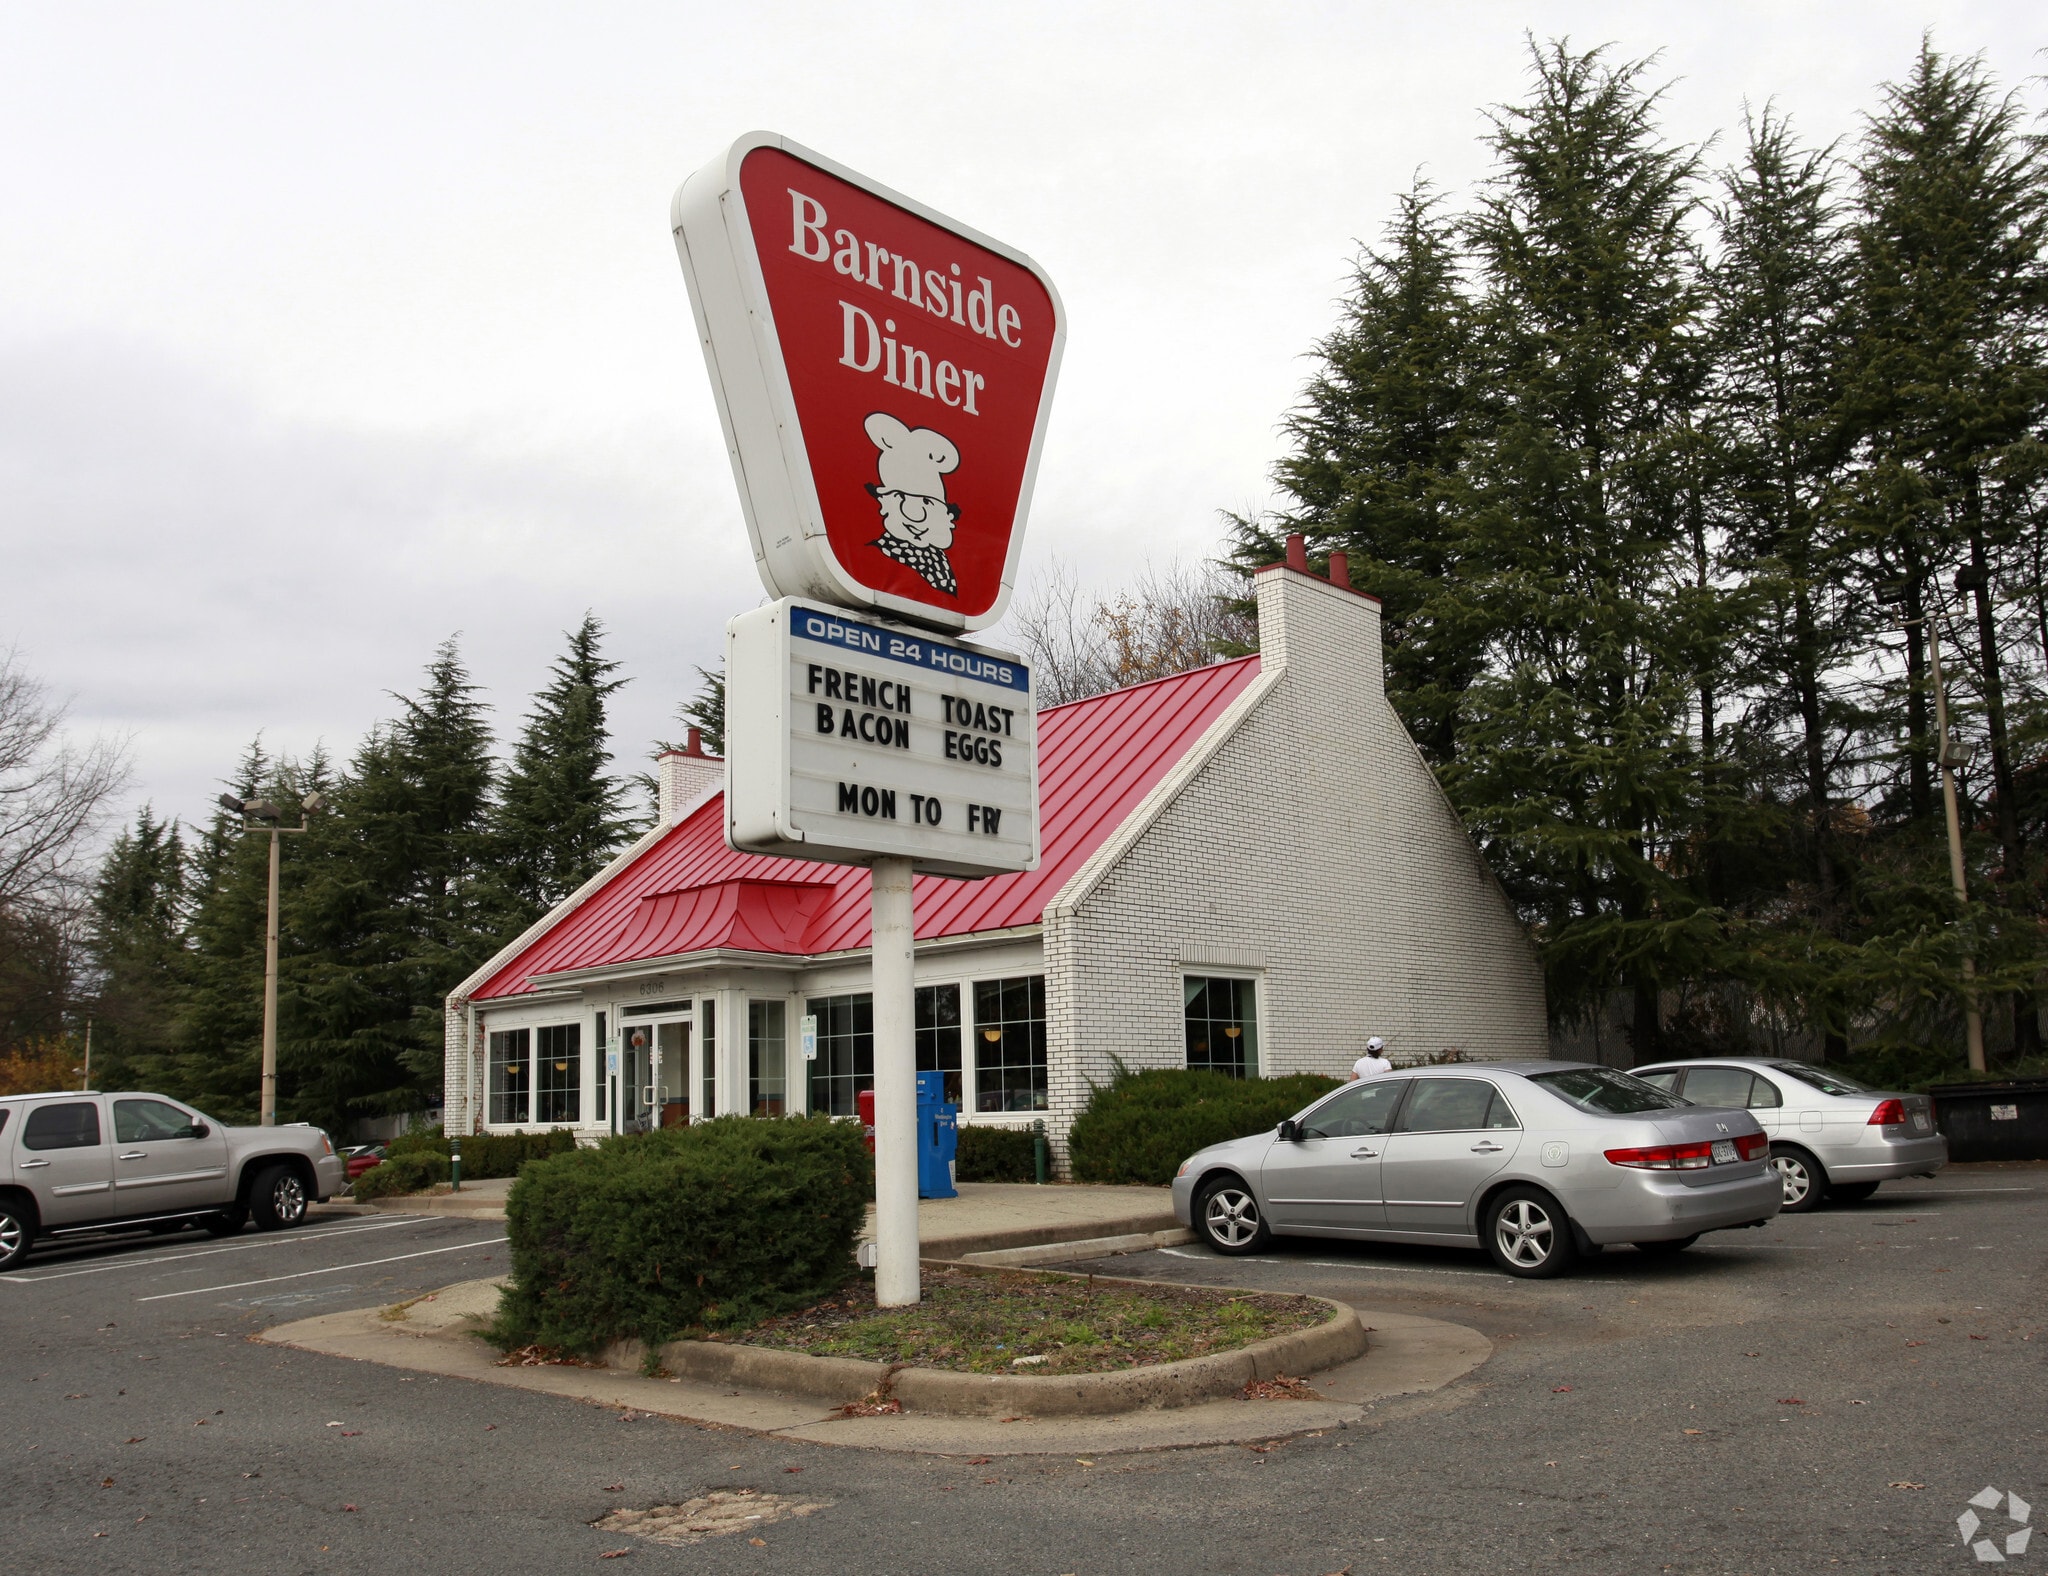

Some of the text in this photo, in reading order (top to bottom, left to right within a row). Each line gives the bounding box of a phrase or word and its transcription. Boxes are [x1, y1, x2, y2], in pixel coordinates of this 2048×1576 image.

[787, 187, 1022, 348] Barnside
[838, 299, 985, 416] Diner
[806, 618, 1013, 684] OPEN 24 HOURS
[808, 663, 1015, 737] FRENCH TOAST
[816, 702, 1003, 768] BACON EGGS
[838, 781, 897, 820] MON
[910, 793, 943, 826] TO
